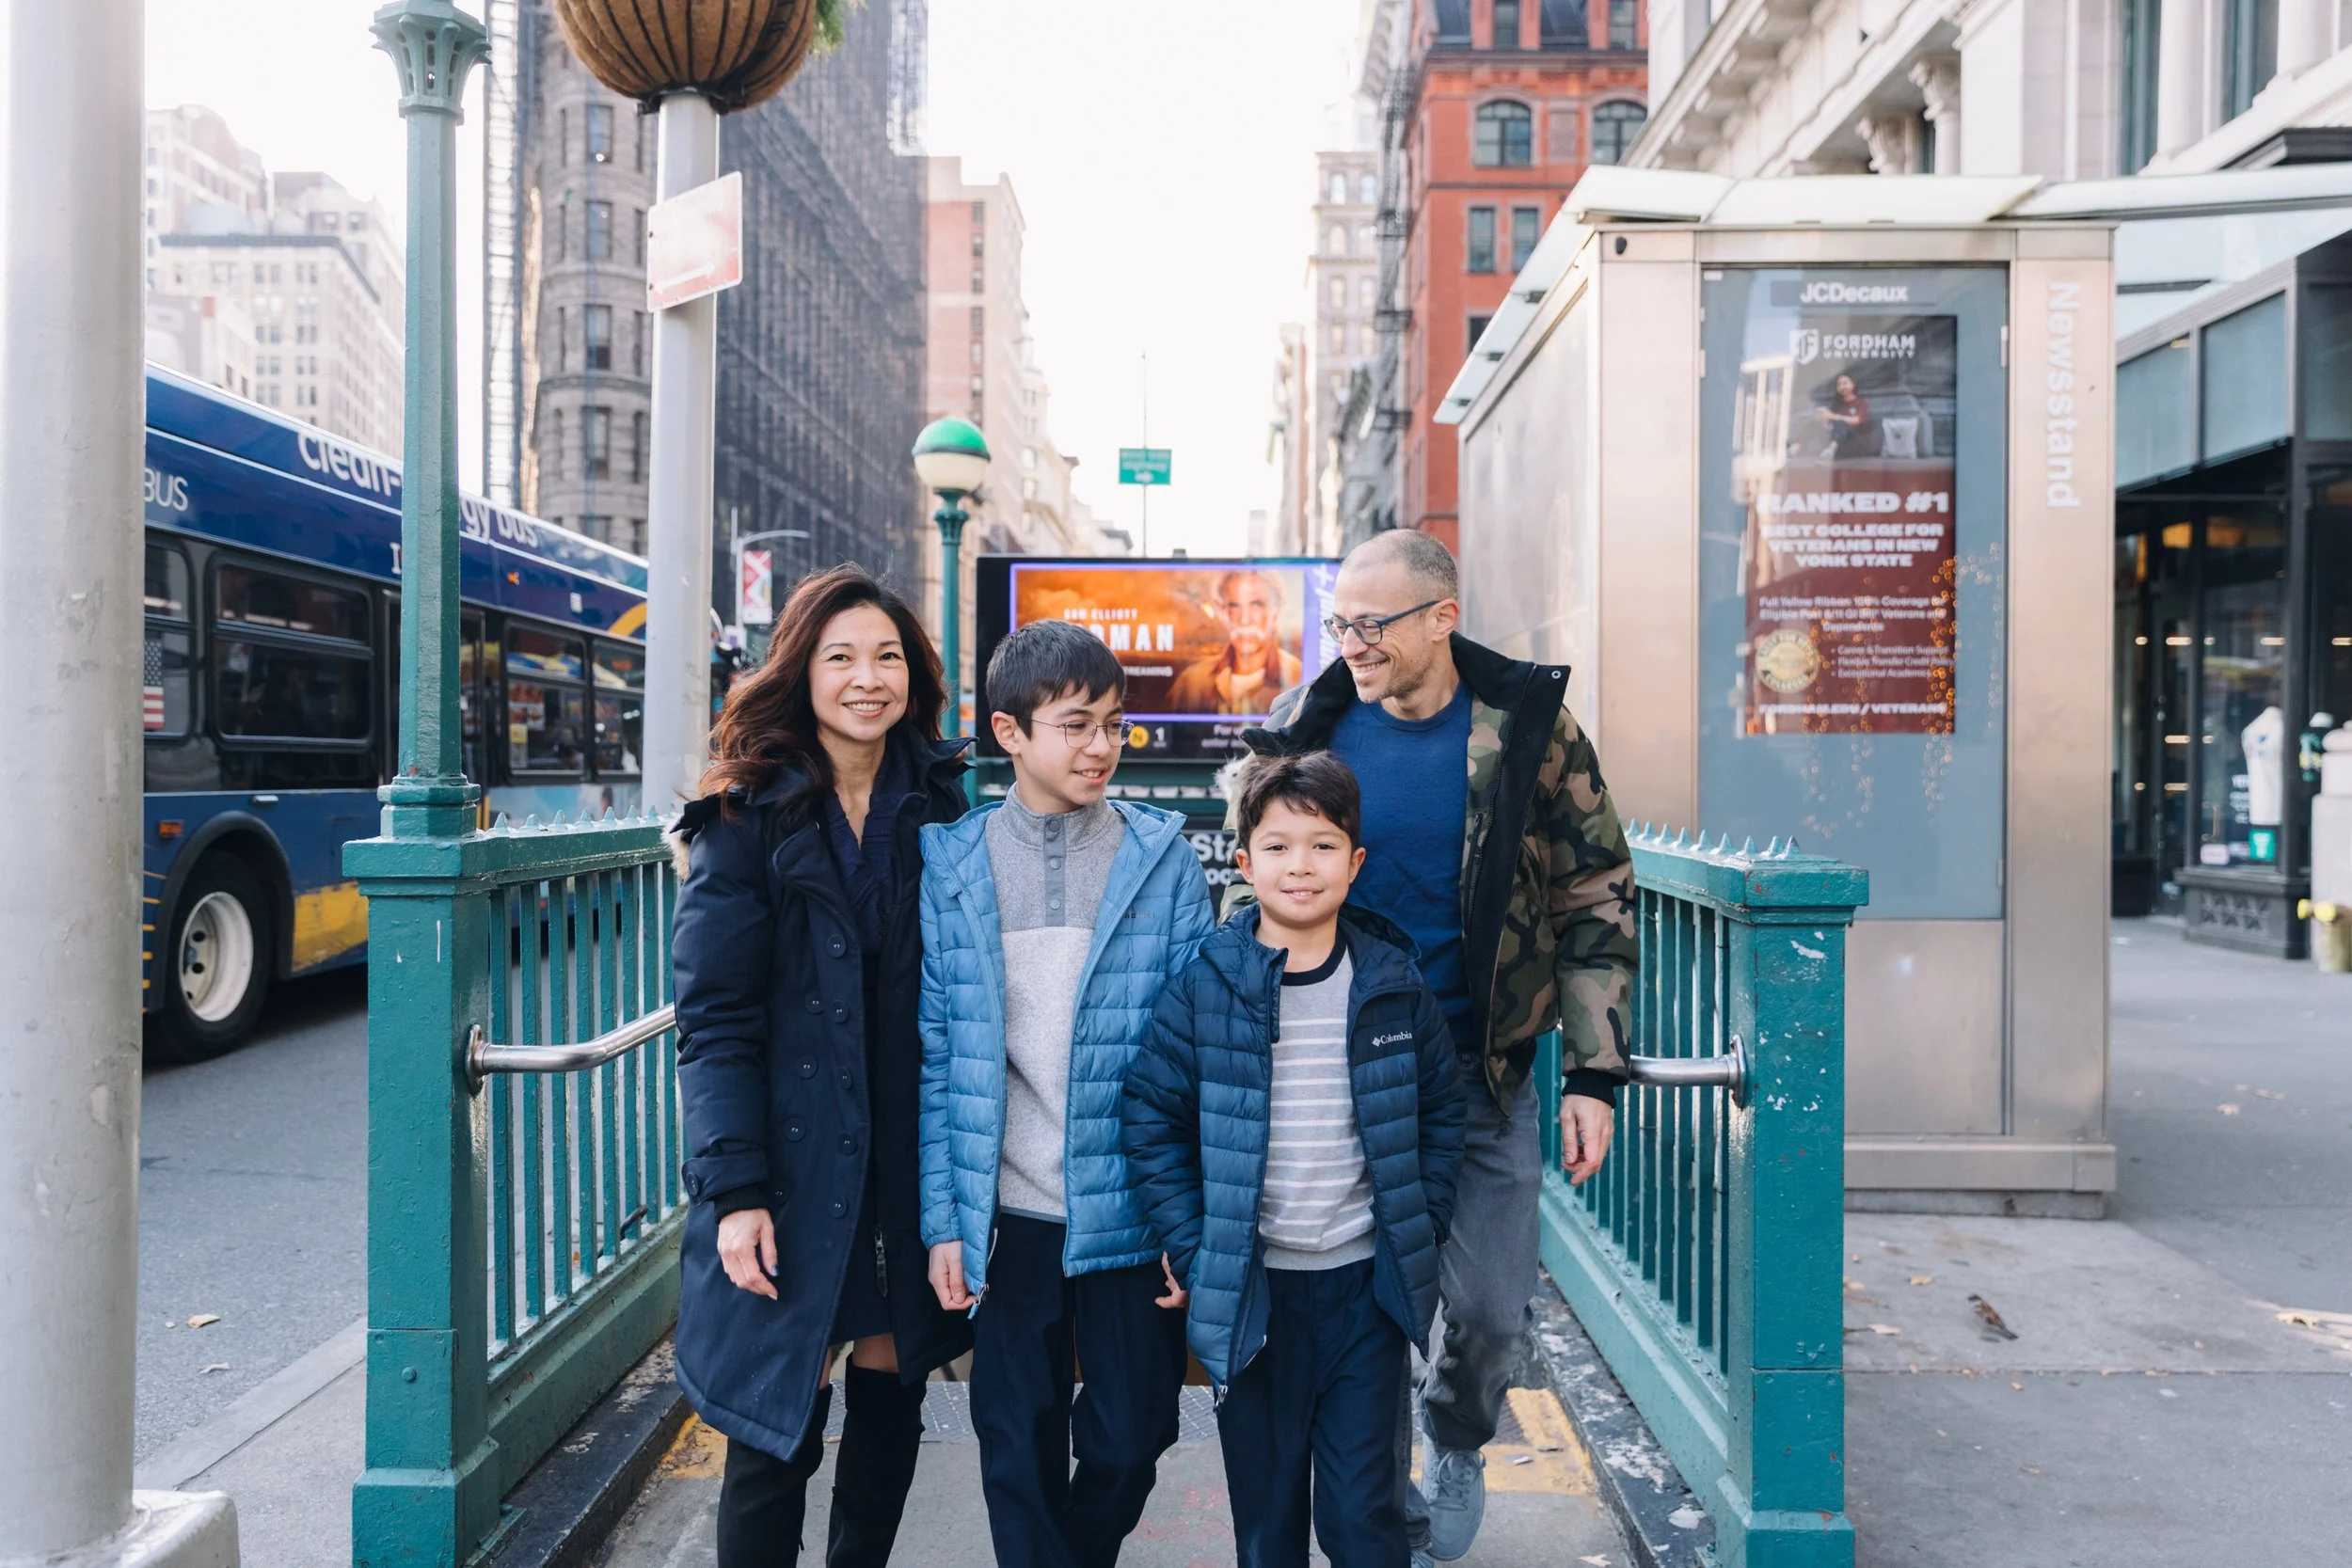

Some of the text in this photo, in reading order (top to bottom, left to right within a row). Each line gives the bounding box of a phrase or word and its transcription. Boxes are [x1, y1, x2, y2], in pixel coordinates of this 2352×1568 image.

[1800, 282, 1908, 302] JCDecaux
[1823, 335, 1915, 349] FORDHAM
[1823, 350, 1915, 358] UNIVERSITY
[2046, 282, 2082, 508] Newsstand
[144, 467, 188, 512] BUS
[1756, 492, 1948, 513] RANKED #1
[1762, 523, 1945, 537] BEST COLLEGE FOR
[1769, 539, 1940, 552] VETERANS IN NEW
[1795, 553, 1914, 567] YORK STATE
[1155, 727, 1165, 741] 1
[1380, 1031, 1412, 1044] Columbia
